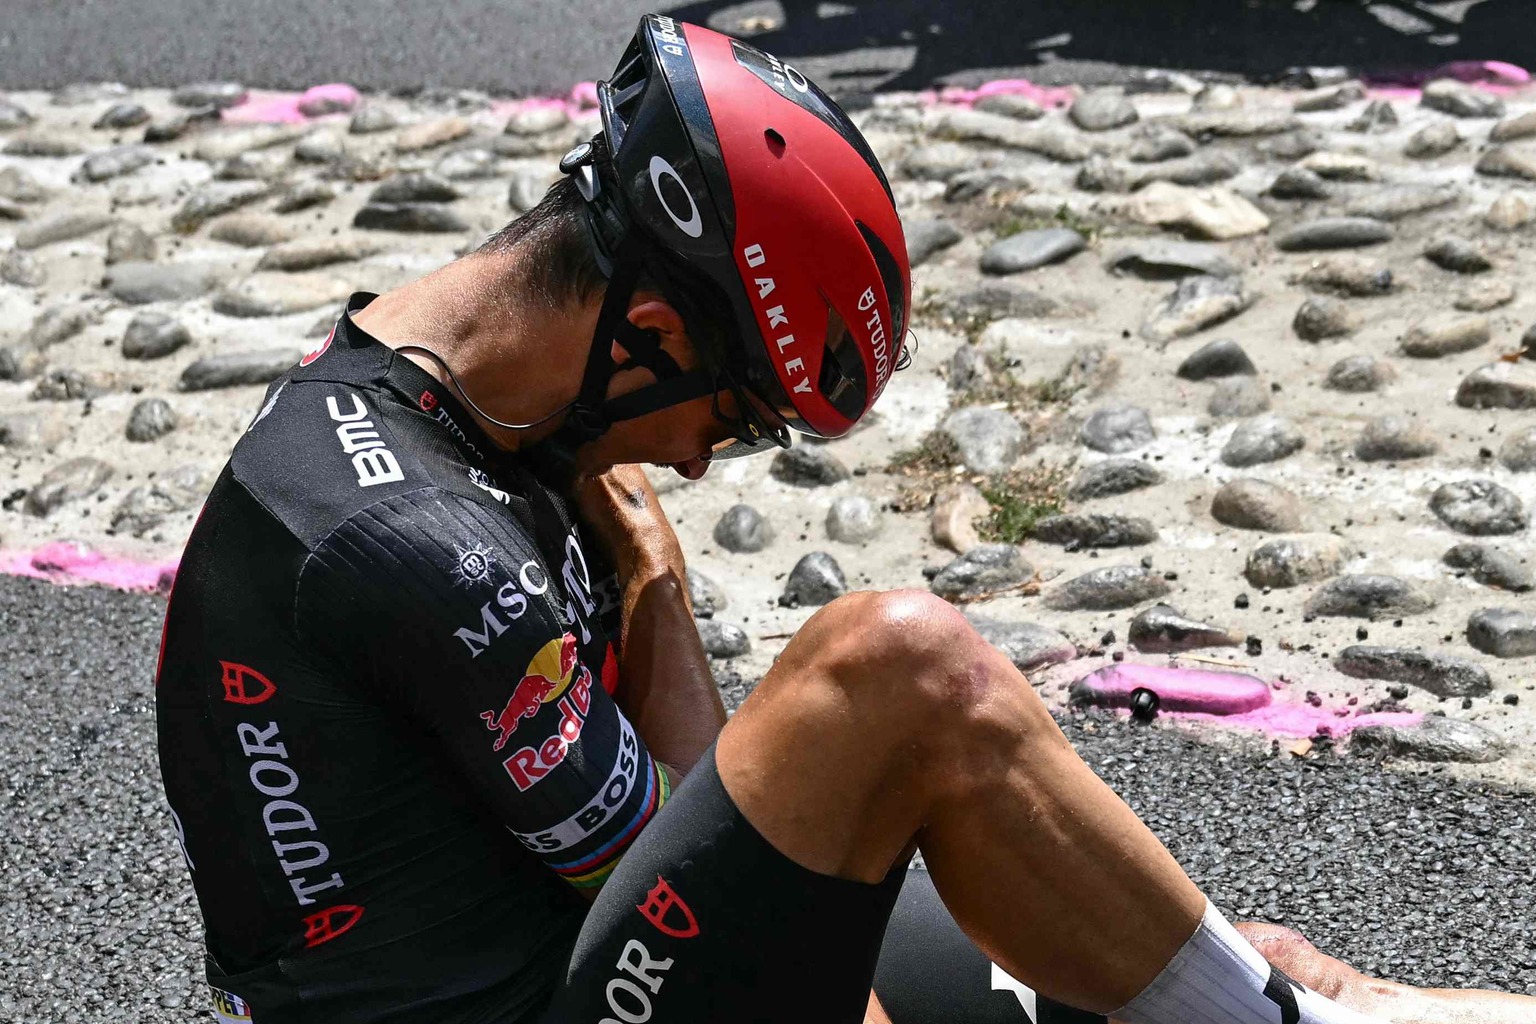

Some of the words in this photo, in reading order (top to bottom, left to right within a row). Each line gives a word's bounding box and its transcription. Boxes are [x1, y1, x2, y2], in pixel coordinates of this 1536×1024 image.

[744, 243, 813, 394] OAKLEY
[866, 308, 891, 388] TUDOR
[325, 392, 405, 488] BMC
[452, 559, 549, 659] MSC
[502, 696, 585, 793] Red
[574, 730, 637, 833] BOSS
[236, 720, 345, 906] TUDOR
